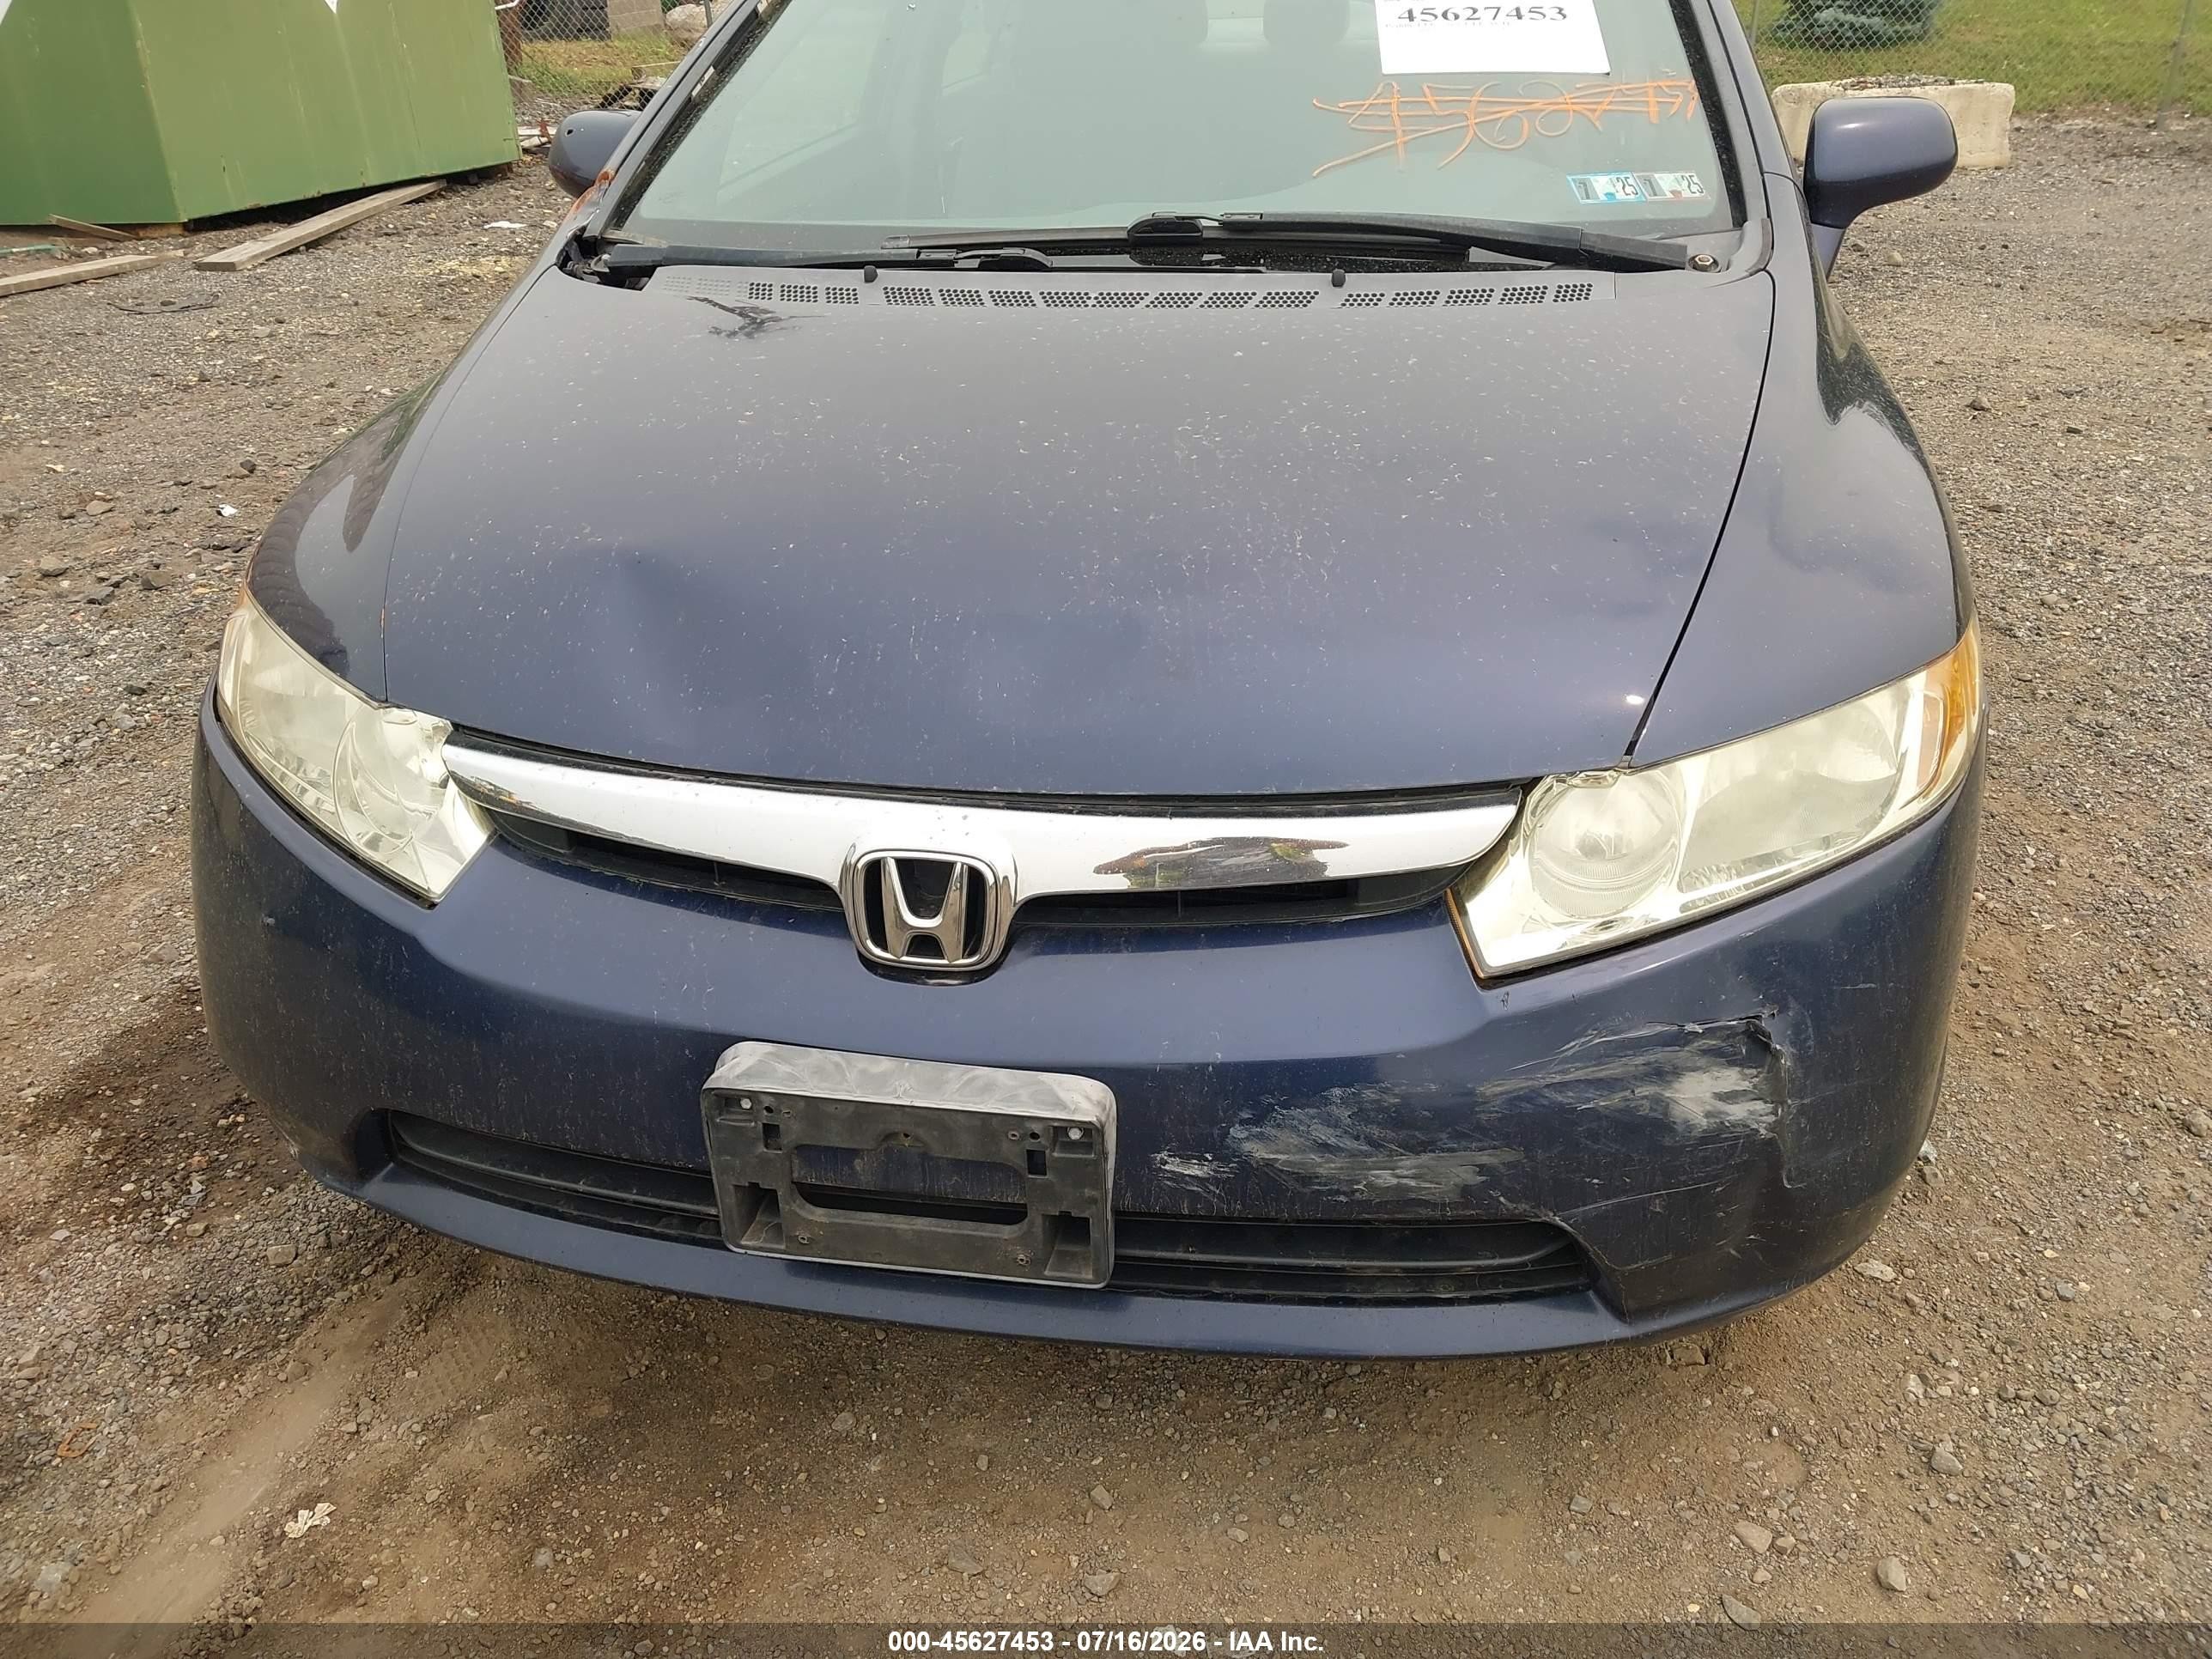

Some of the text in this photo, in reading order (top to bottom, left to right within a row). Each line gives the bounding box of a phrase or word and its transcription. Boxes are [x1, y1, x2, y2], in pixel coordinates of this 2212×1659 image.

[1397, 6, 1567, 23] 45627453
[1616, 175, 1639, 197] 25
[1680, 173, 1705, 195] 25
